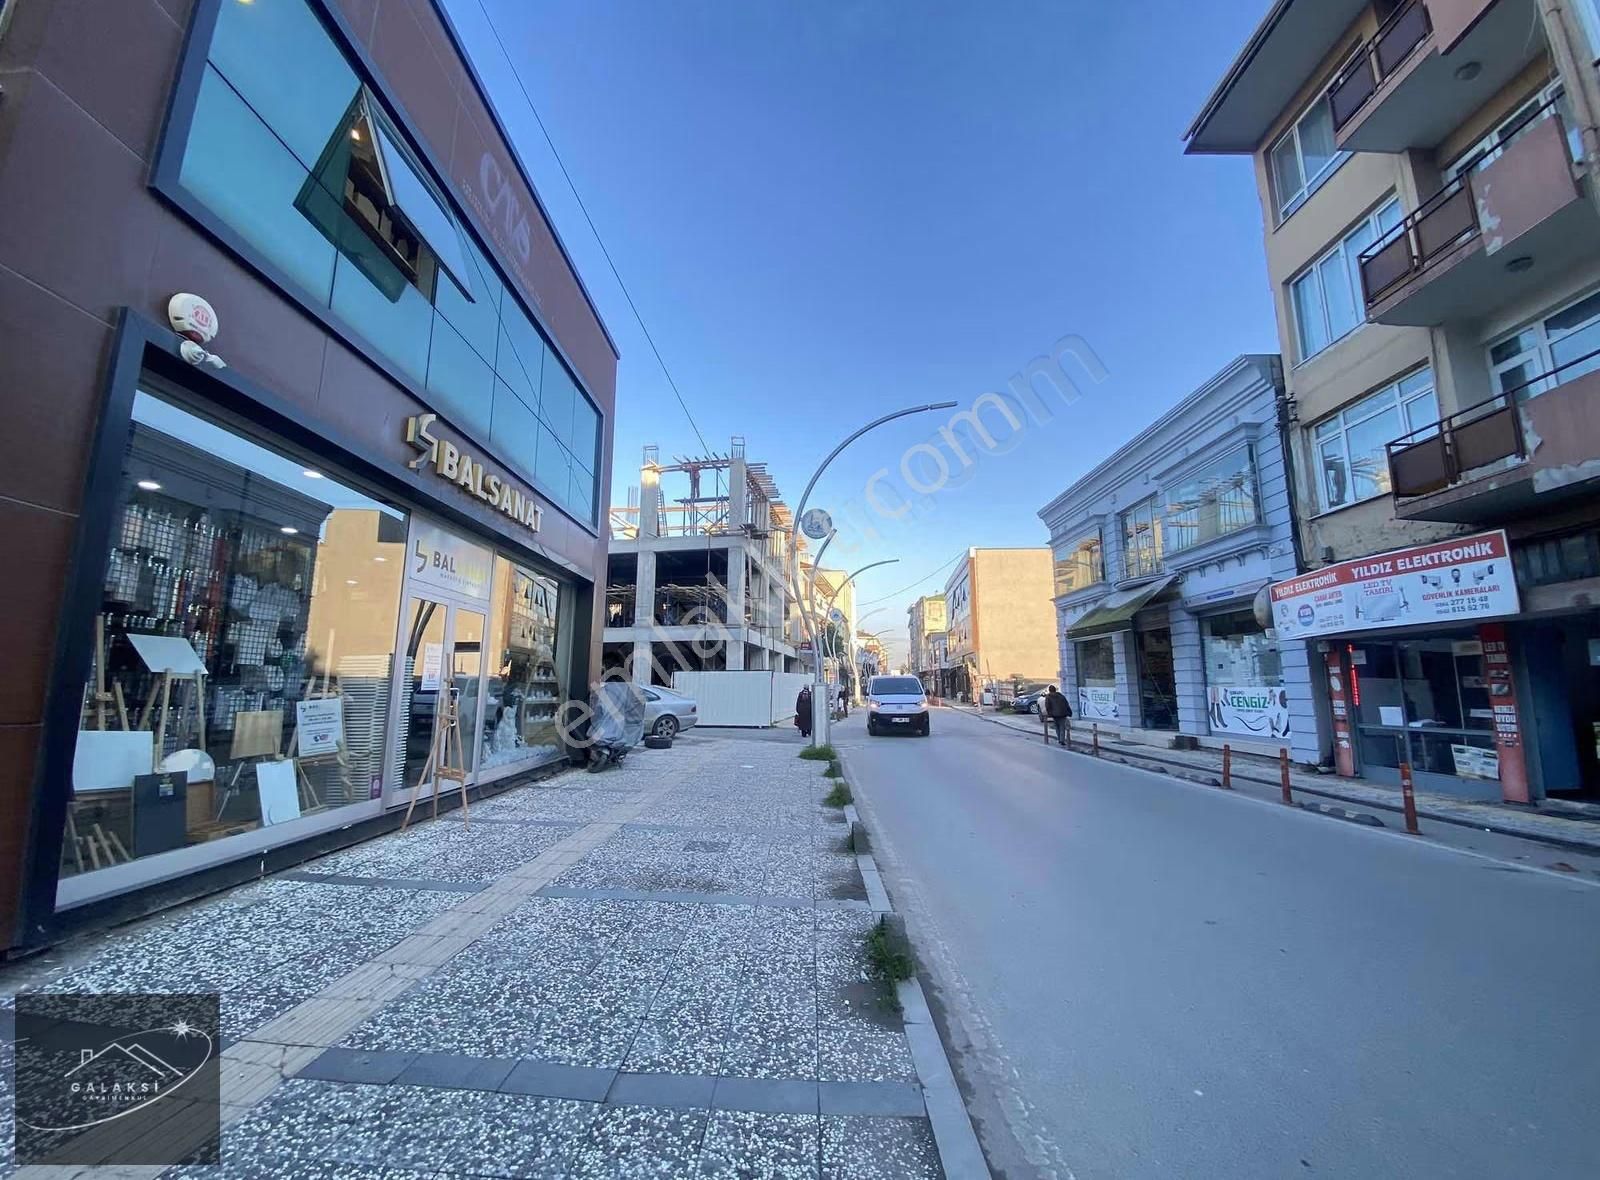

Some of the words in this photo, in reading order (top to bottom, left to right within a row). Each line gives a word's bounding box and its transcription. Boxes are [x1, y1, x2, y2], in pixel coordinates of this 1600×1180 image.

[437, 440, 544, 533] BALSANAT
[1352, 561, 1393, 580] YILDIZ
[1397, 542, 1493, 571] ELEKTRONİK
[1275, 585, 1295, 599] YILDIZ
[1296, 572, 1338, 591] ELEKTRONİK
[1363, 581, 1380, 589] LED
[1450, 598, 1465, 606] 277
[1231, 692, 1269, 708] CENGİZ
